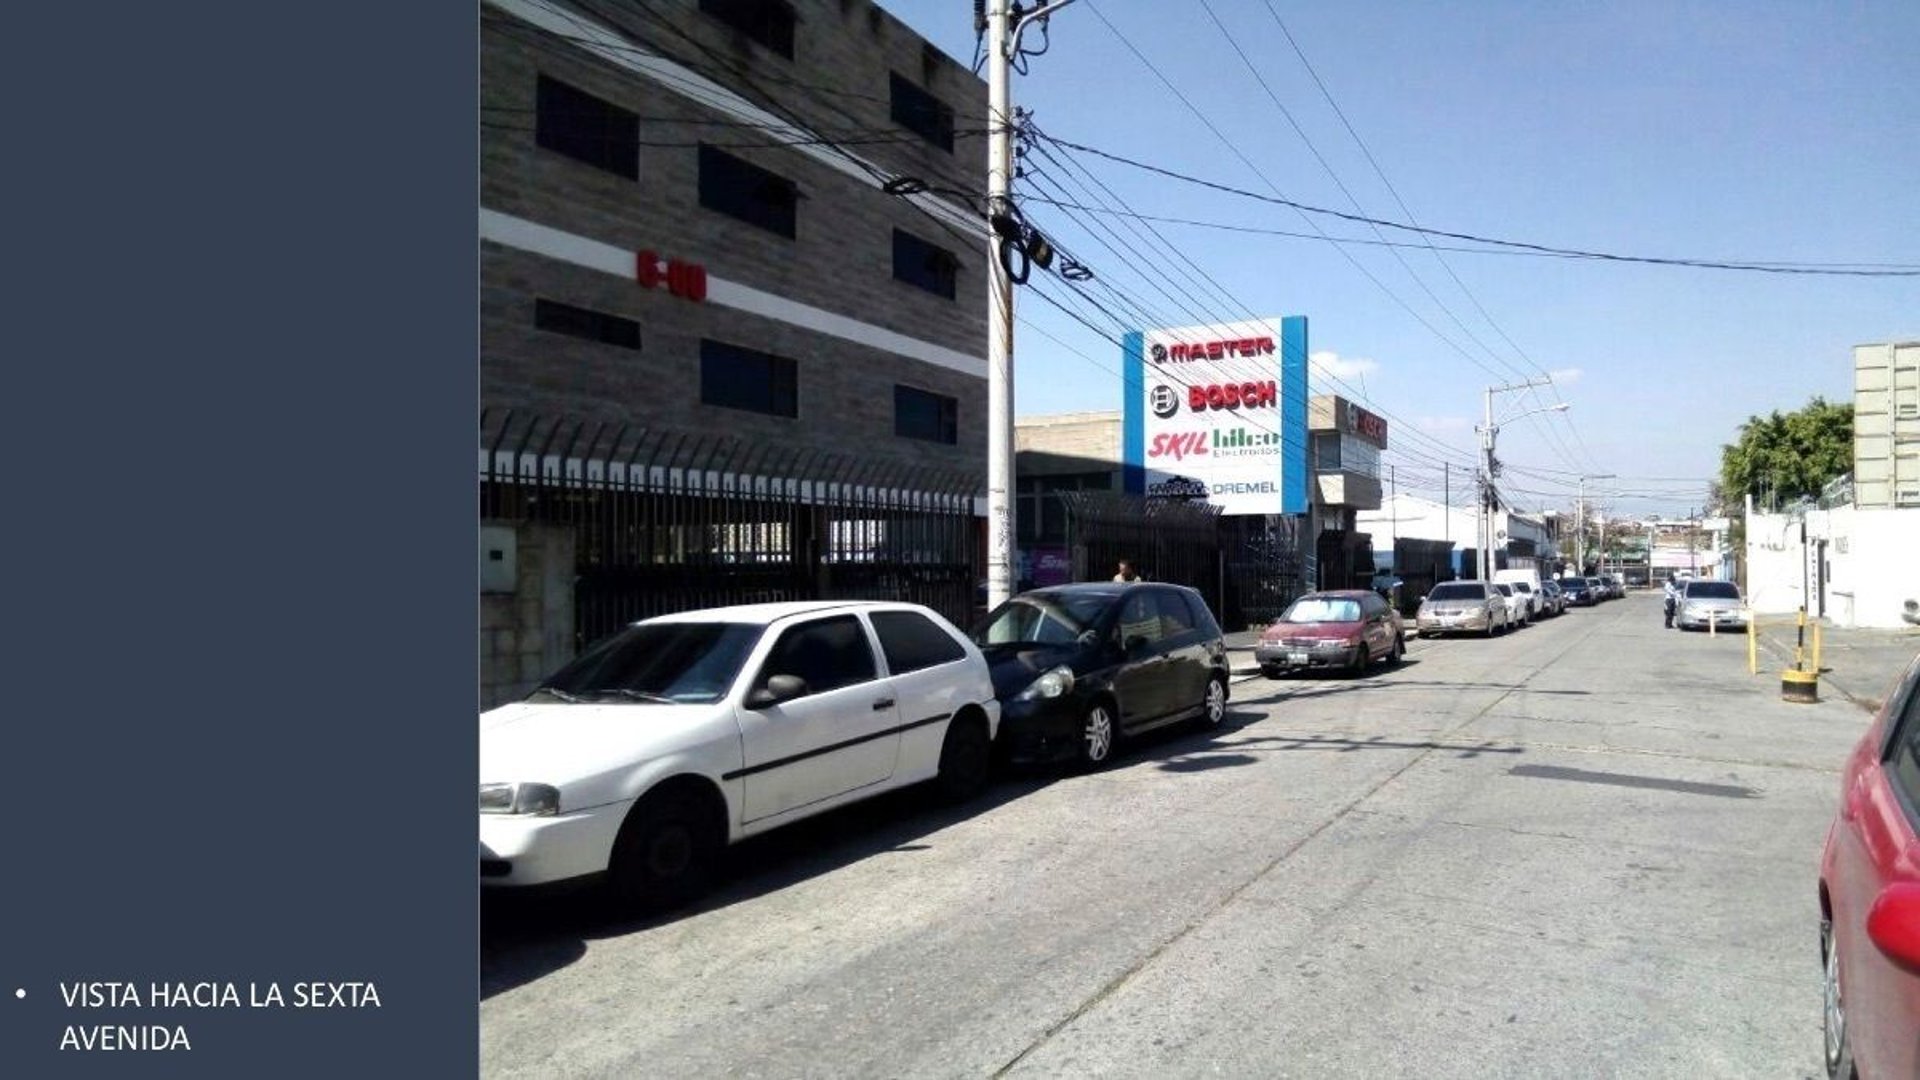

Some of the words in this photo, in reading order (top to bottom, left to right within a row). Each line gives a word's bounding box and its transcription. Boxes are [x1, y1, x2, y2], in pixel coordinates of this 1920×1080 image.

[1169, 337, 1276, 363] MASTER
[1188, 380, 1277, 413] BOSCH
[1148, 431, 1209, 461] SKIL
[1213, 481, 1279, 495] DREMEL
